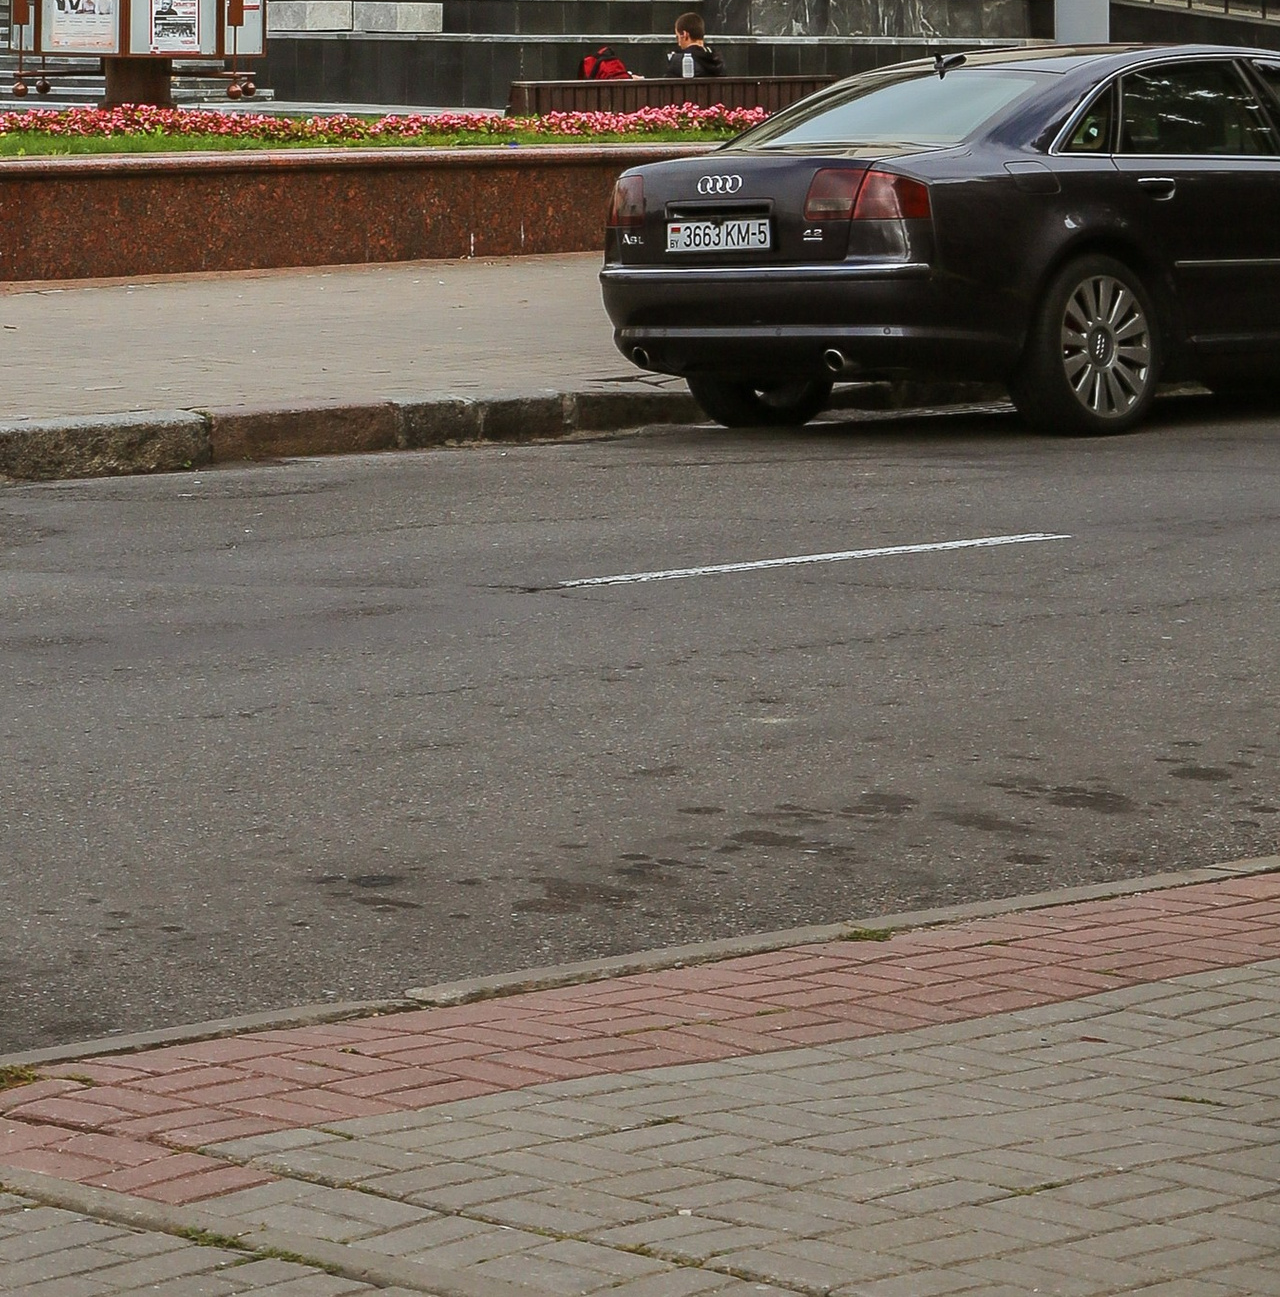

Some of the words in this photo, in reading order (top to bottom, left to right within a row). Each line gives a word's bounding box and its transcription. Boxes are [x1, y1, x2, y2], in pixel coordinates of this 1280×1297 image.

[683, 225, 721, 247] 3663
[725, 222, 767, 246] KM-5
[670, 239, 680, 249] BY
